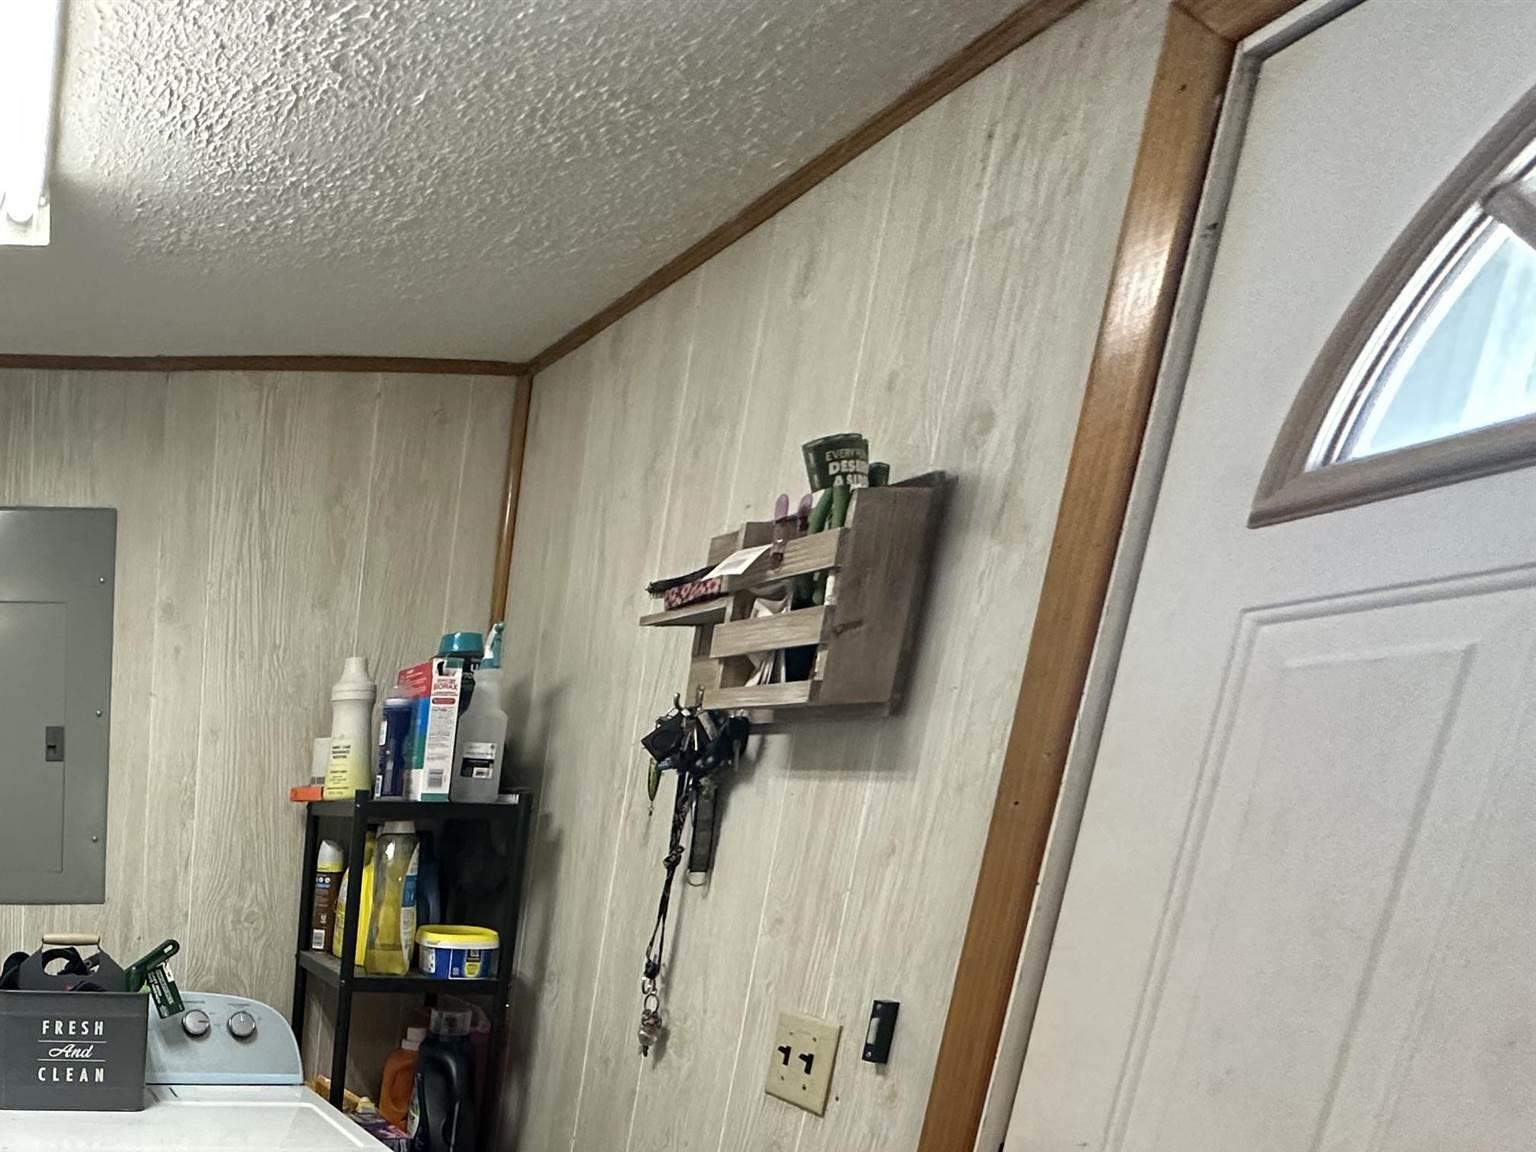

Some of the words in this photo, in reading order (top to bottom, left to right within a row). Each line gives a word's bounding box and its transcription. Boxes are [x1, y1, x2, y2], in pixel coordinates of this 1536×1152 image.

[42, 1020, 104, 1035] FRESH
[48, 1043, 94, 1058] And
[38, 1067, 104, 1082] CLEAN
